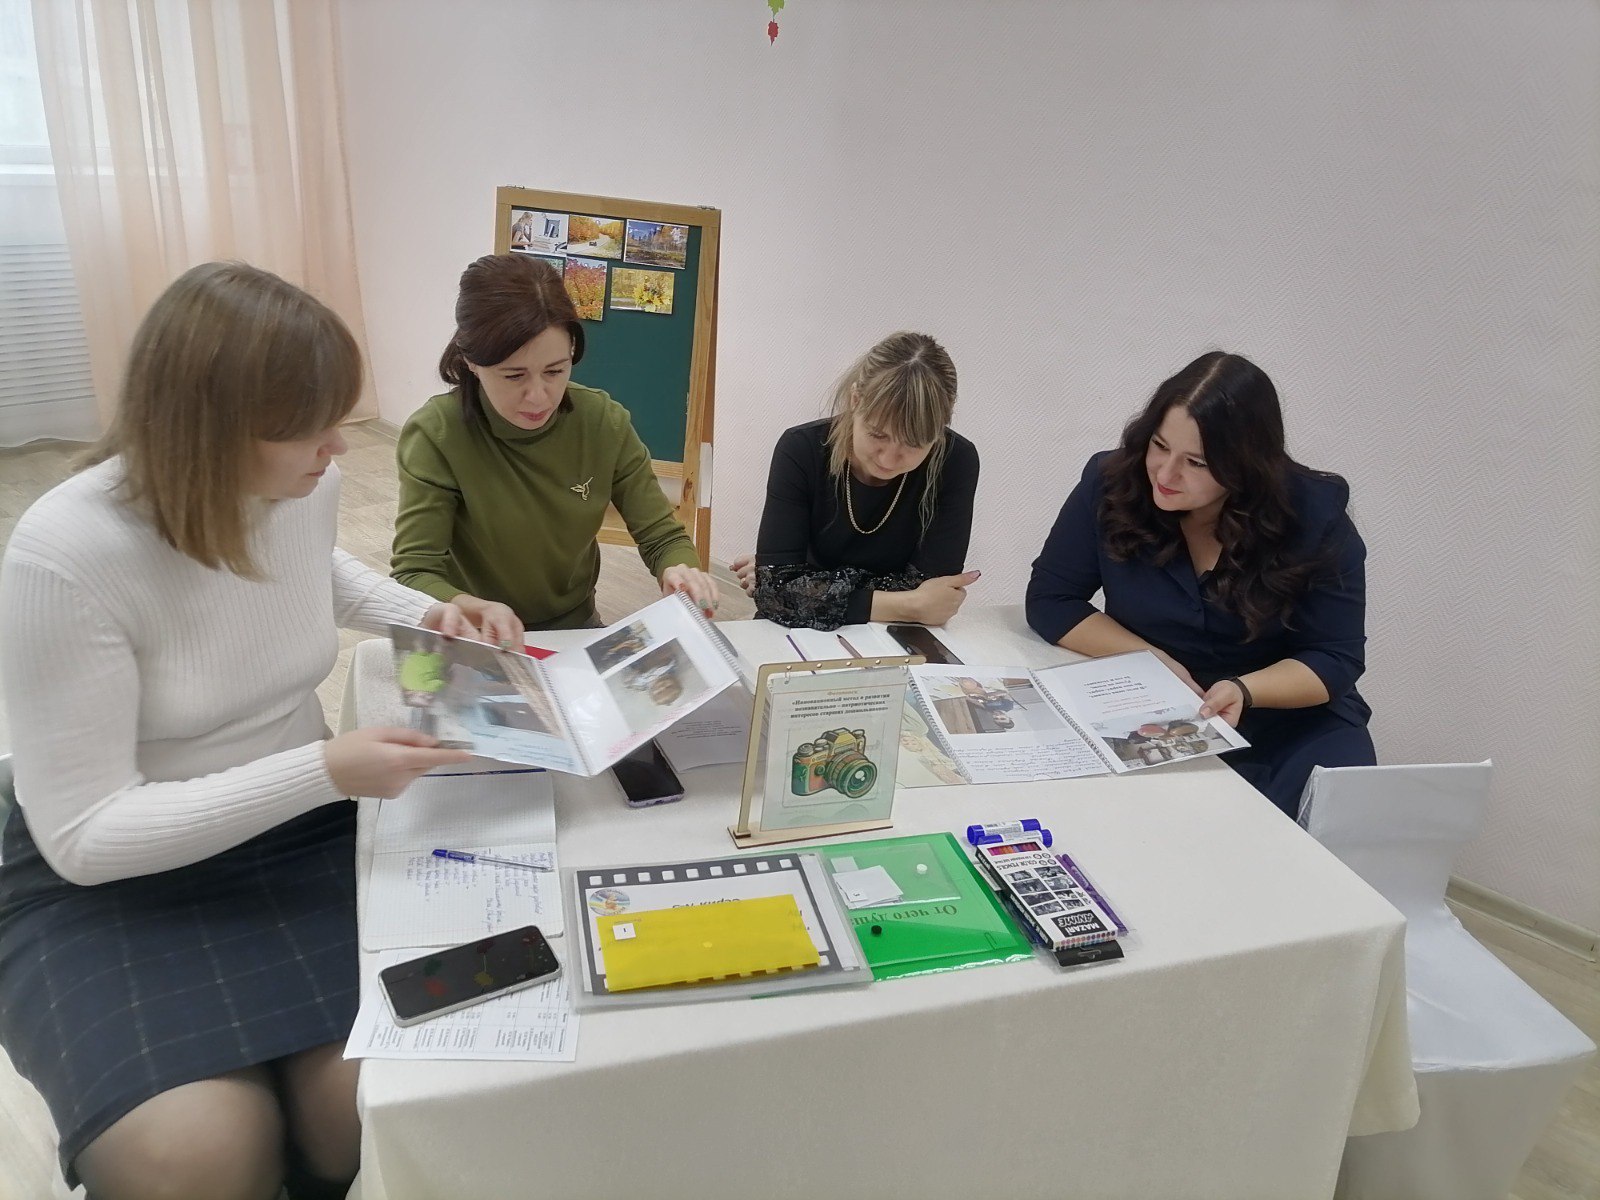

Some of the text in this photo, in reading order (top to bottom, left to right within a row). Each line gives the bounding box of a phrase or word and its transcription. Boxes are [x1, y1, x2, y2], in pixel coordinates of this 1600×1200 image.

[893, 908, 930, 920] чего
[934, 904, 958, 916] От
[1057, 912, 1095, 928] ANIME
